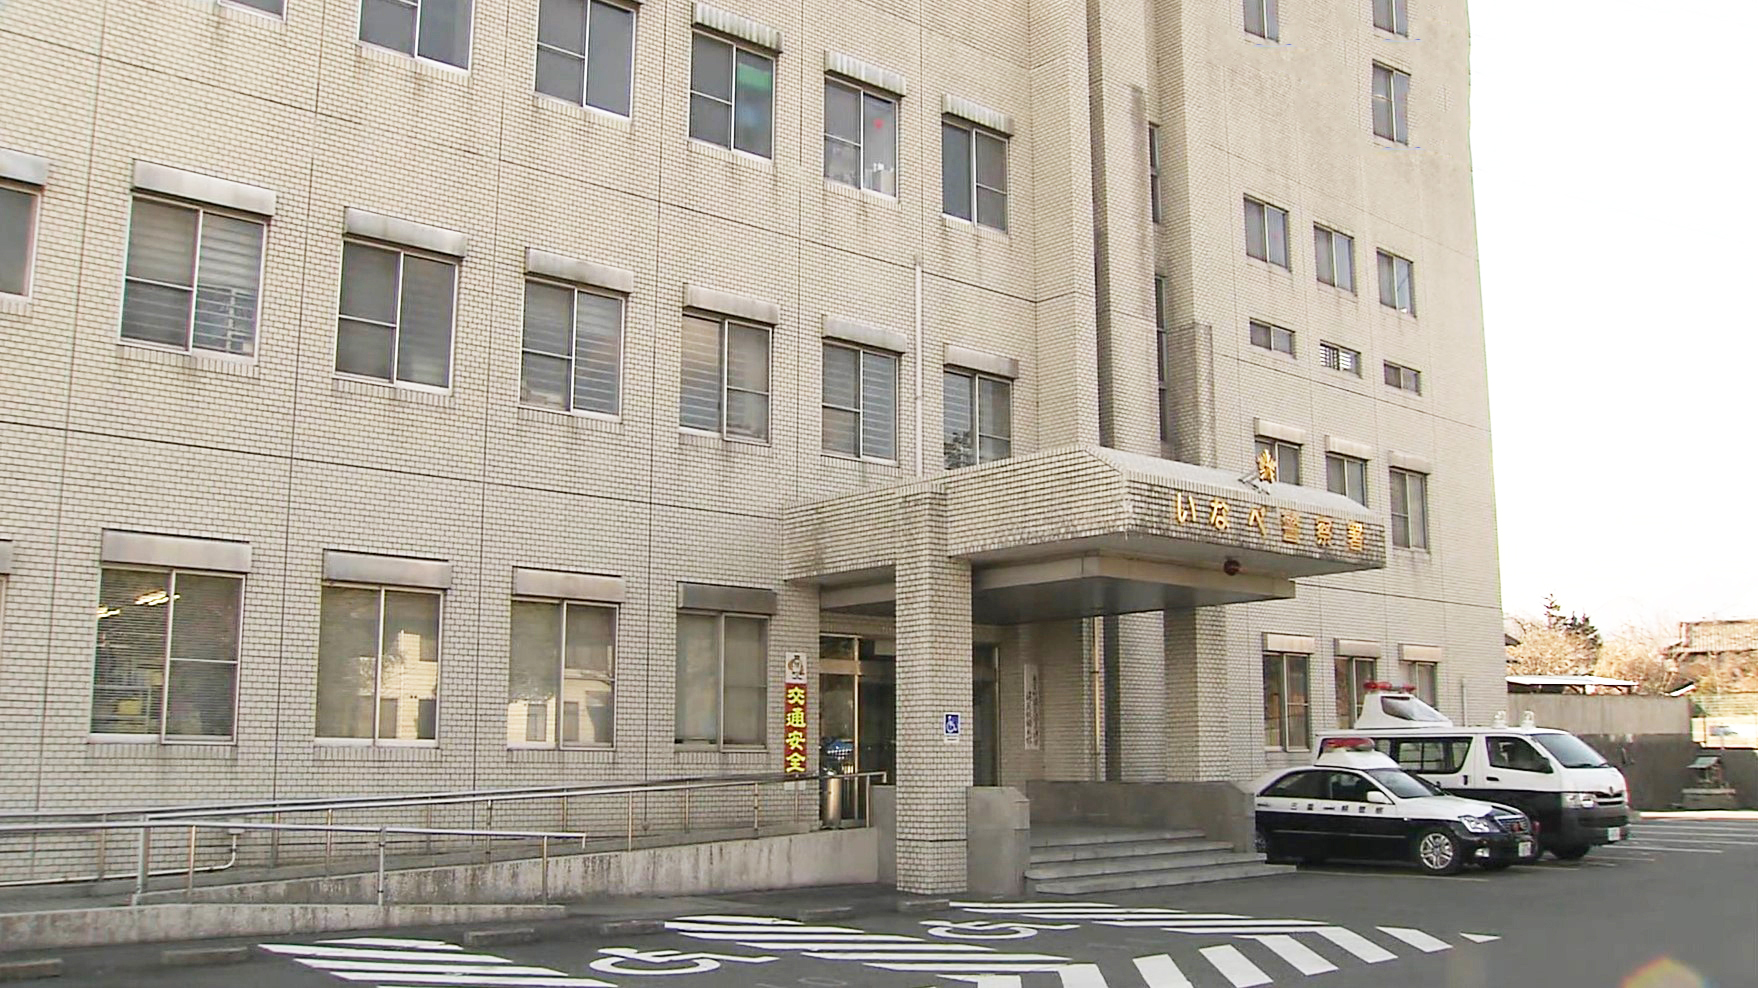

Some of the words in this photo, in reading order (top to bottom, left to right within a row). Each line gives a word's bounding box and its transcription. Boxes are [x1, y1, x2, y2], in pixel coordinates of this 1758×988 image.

[1175, 491, 1365, 552] いなべ警察署
[786, 686, 807, 773] 交通安全
